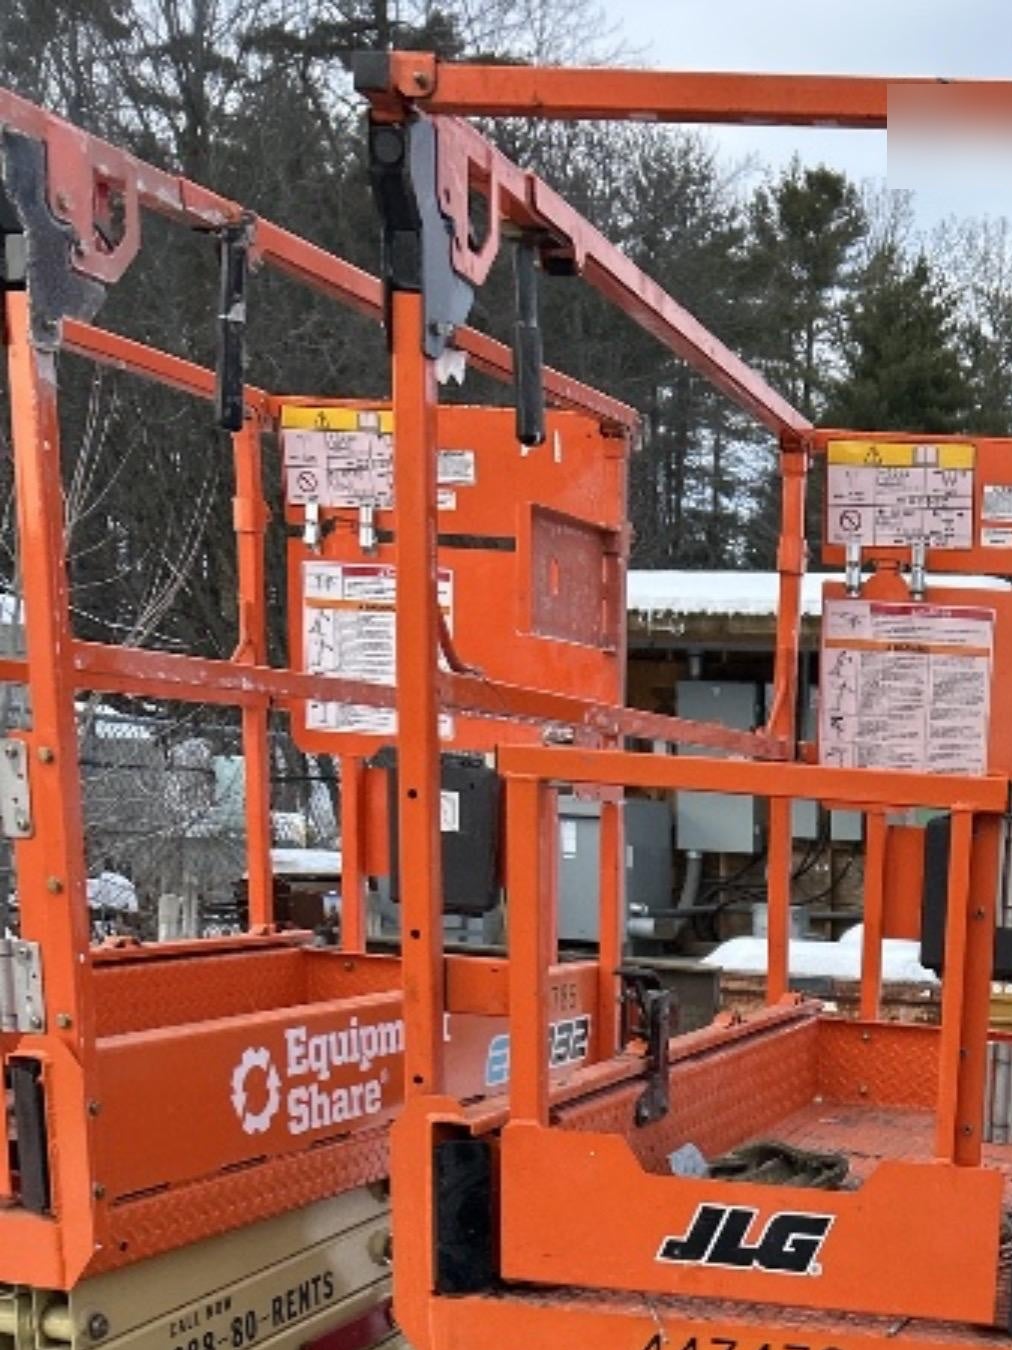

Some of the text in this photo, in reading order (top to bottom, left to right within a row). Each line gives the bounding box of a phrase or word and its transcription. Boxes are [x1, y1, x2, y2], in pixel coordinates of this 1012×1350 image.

[284, 1015, 452, 1082] Equipm
[286, 1078, 383, 1135] Share
[655, 1202, 837, 1277] JLG
